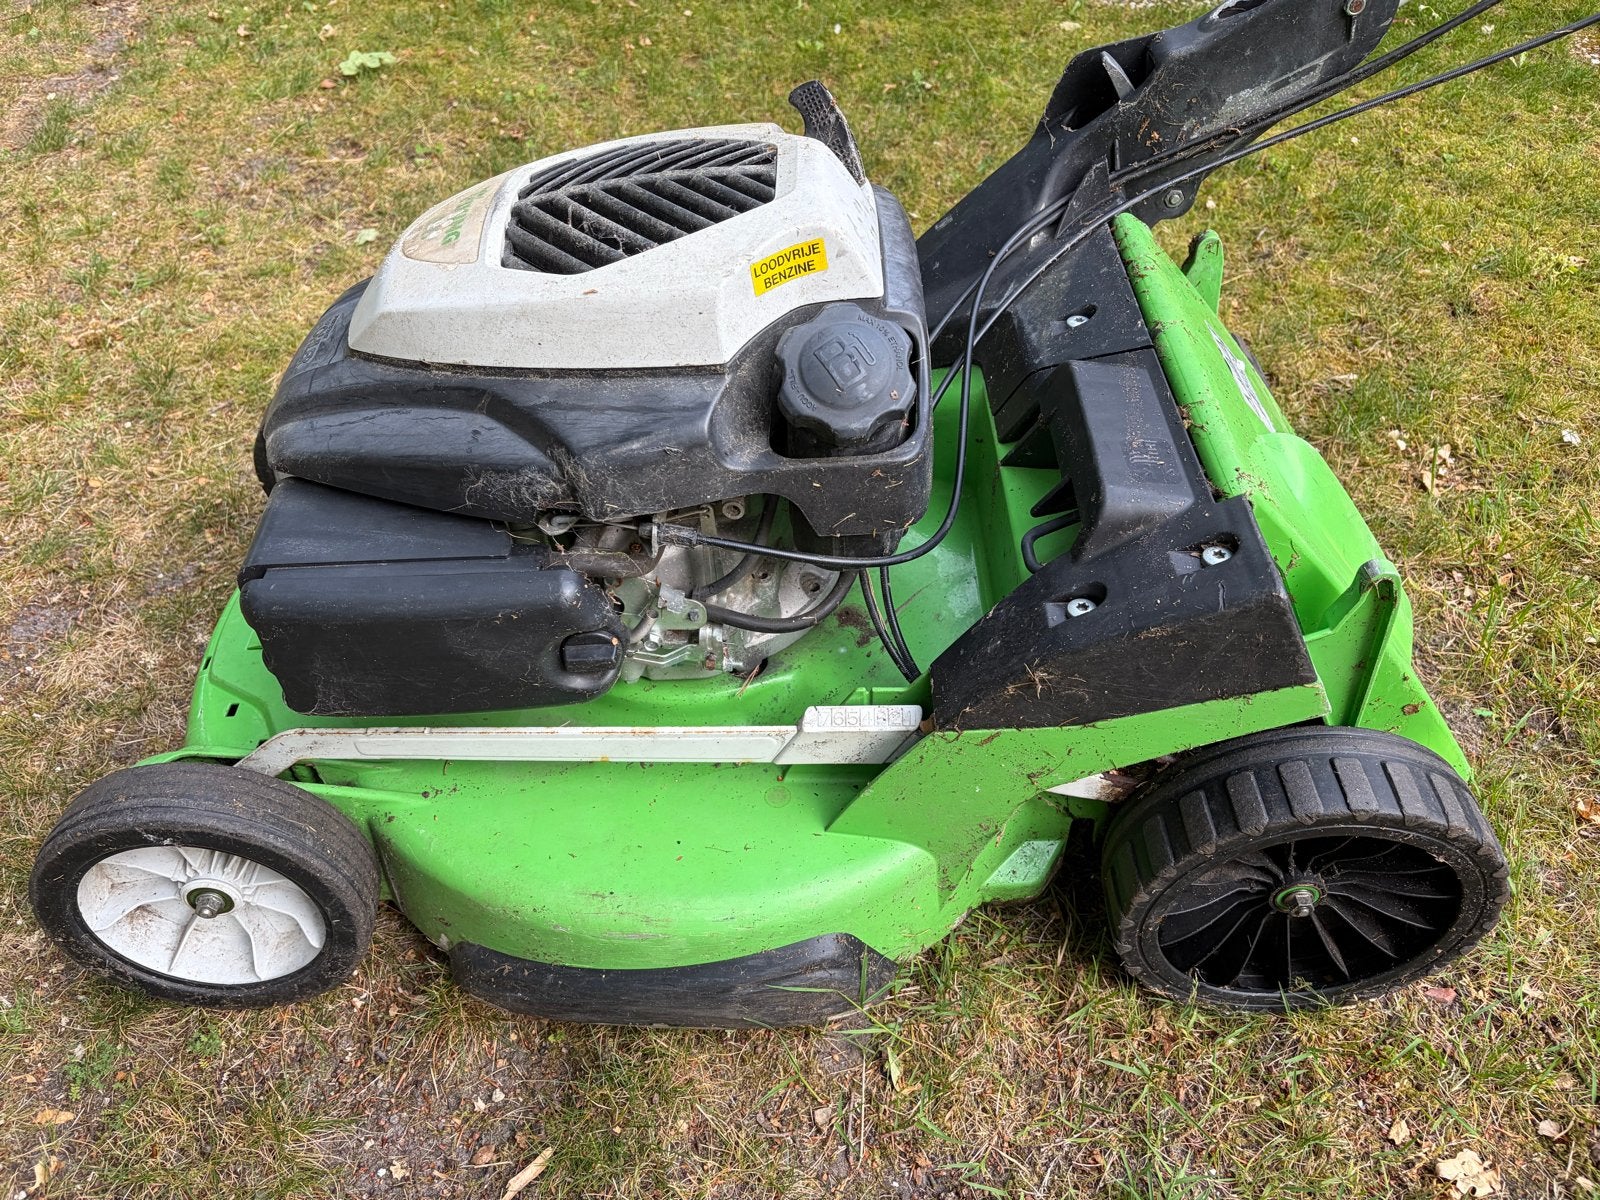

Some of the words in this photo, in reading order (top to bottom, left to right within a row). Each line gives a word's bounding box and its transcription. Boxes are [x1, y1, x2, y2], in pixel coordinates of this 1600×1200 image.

[754, 243, 821, 278] LOODVRIJE
[764, 260, 816, 289] BENZINE
[820, 709, 831, 726] 7
[833, 711, 844, 726] 6
[847, 711, 858, 726] 5
[889, 710, 901, 726] 2
